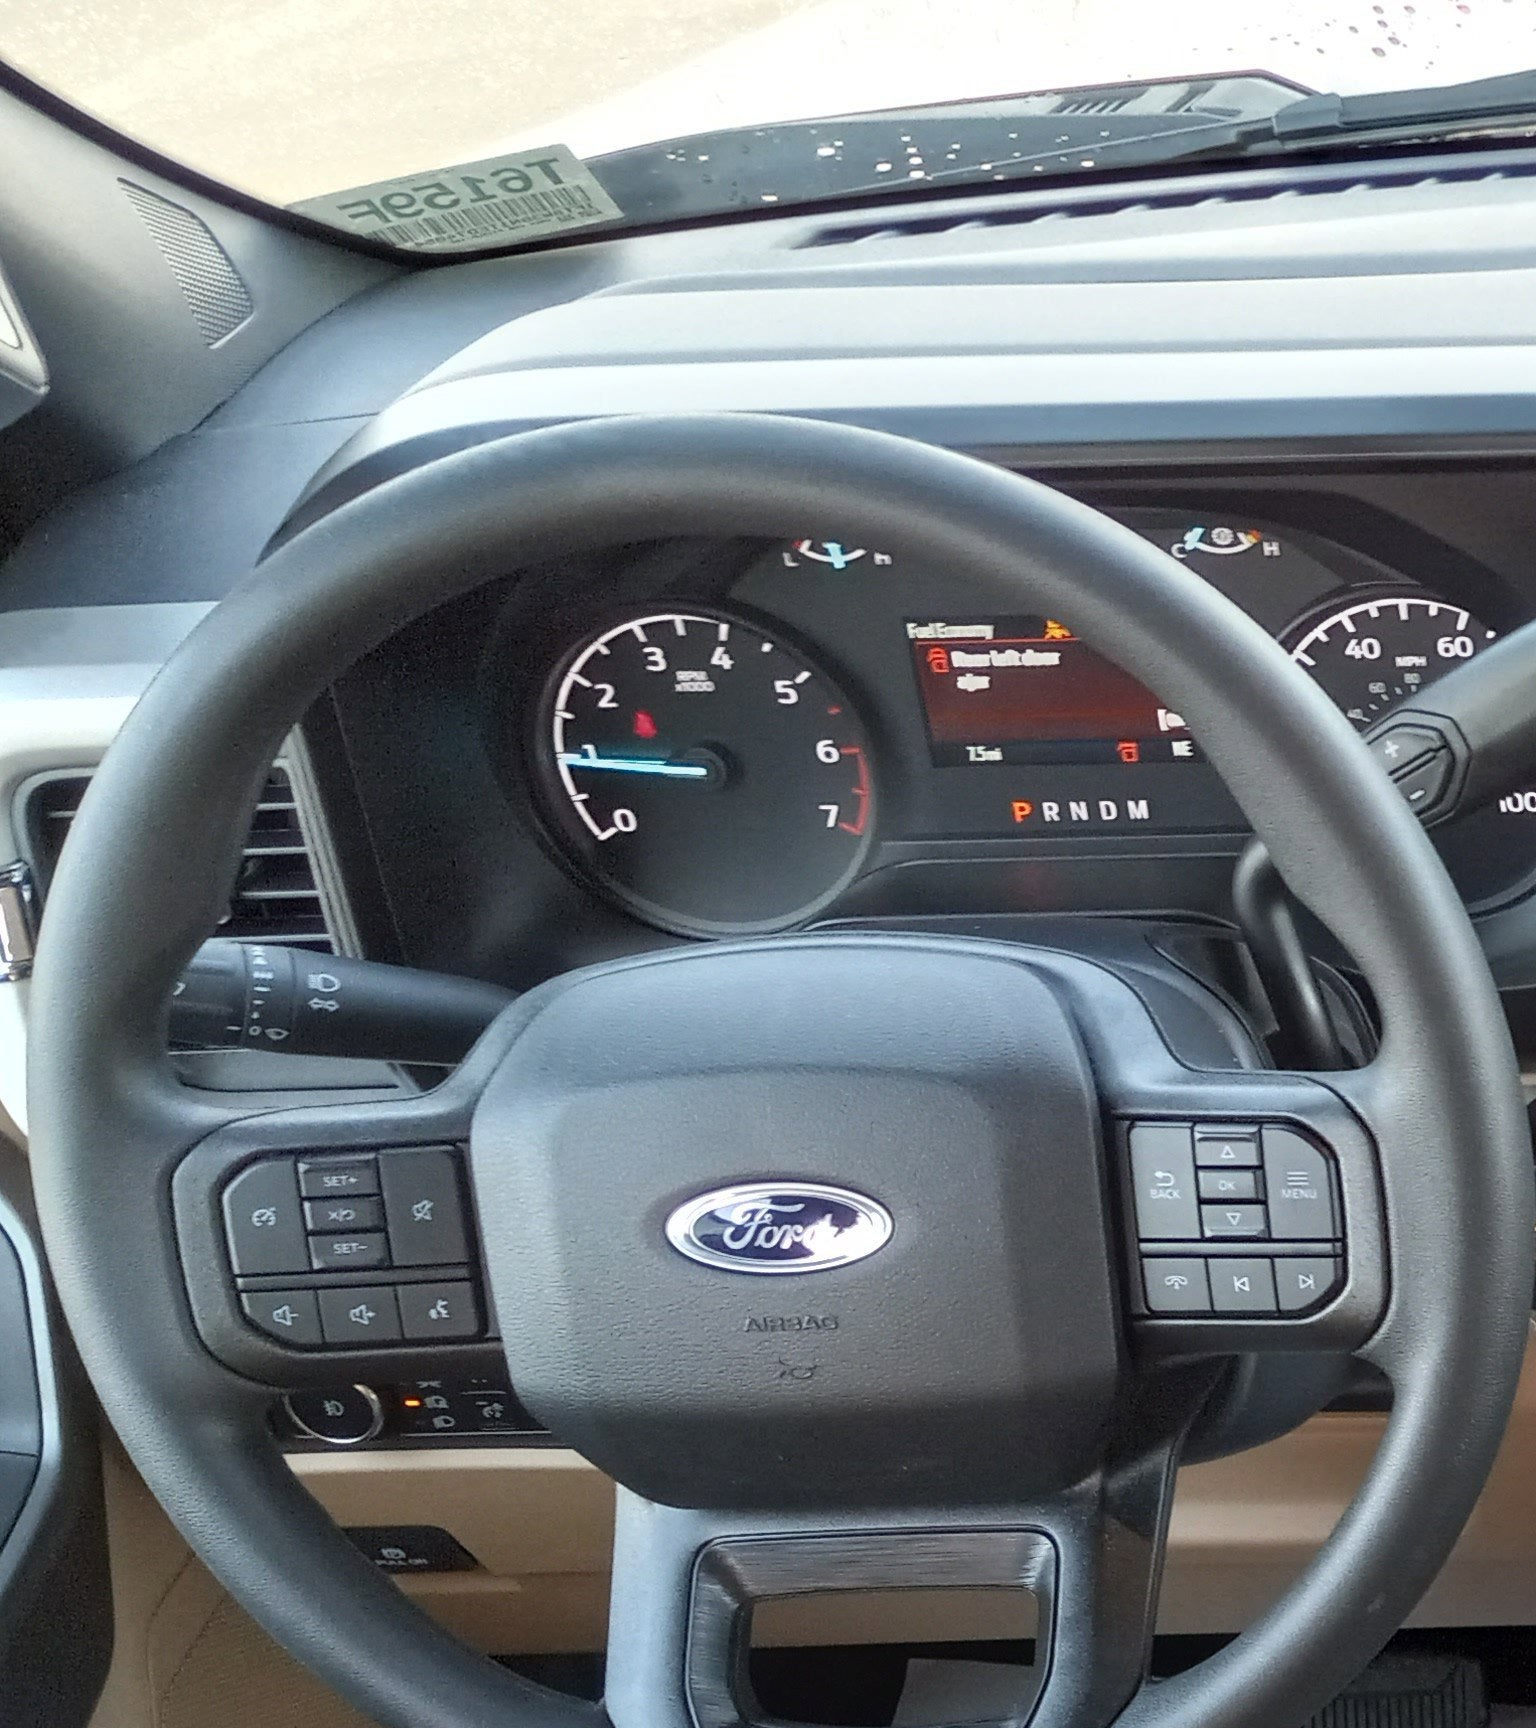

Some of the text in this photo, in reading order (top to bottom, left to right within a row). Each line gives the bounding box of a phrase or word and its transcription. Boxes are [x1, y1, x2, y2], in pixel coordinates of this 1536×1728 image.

[1171, 543, 1188, 558] C
[1262, 541, 1280, 556] H
[710, 646, 735, 670] 4
[1344, 637, 1381, 659] 40
[1436, 635, 1474, 658] 60
[642, 647, 668, 671] 3
[1395, 656, 1428, 667] MPH
[594, 683, 619, 708] 2
[774, 680, 799, 704] 5
[815, 740, 840, 763] 6
[613, 808, 637, 832] 0
[818, 804, 839, 828] 7
[1011, 799, 1149, 822] P R N D M
[1150, 1188, 1182, 1199] BACK
[1218, 1179, 1236, 1191] OK
[1281, 1188, 1318, 1199] MENU
